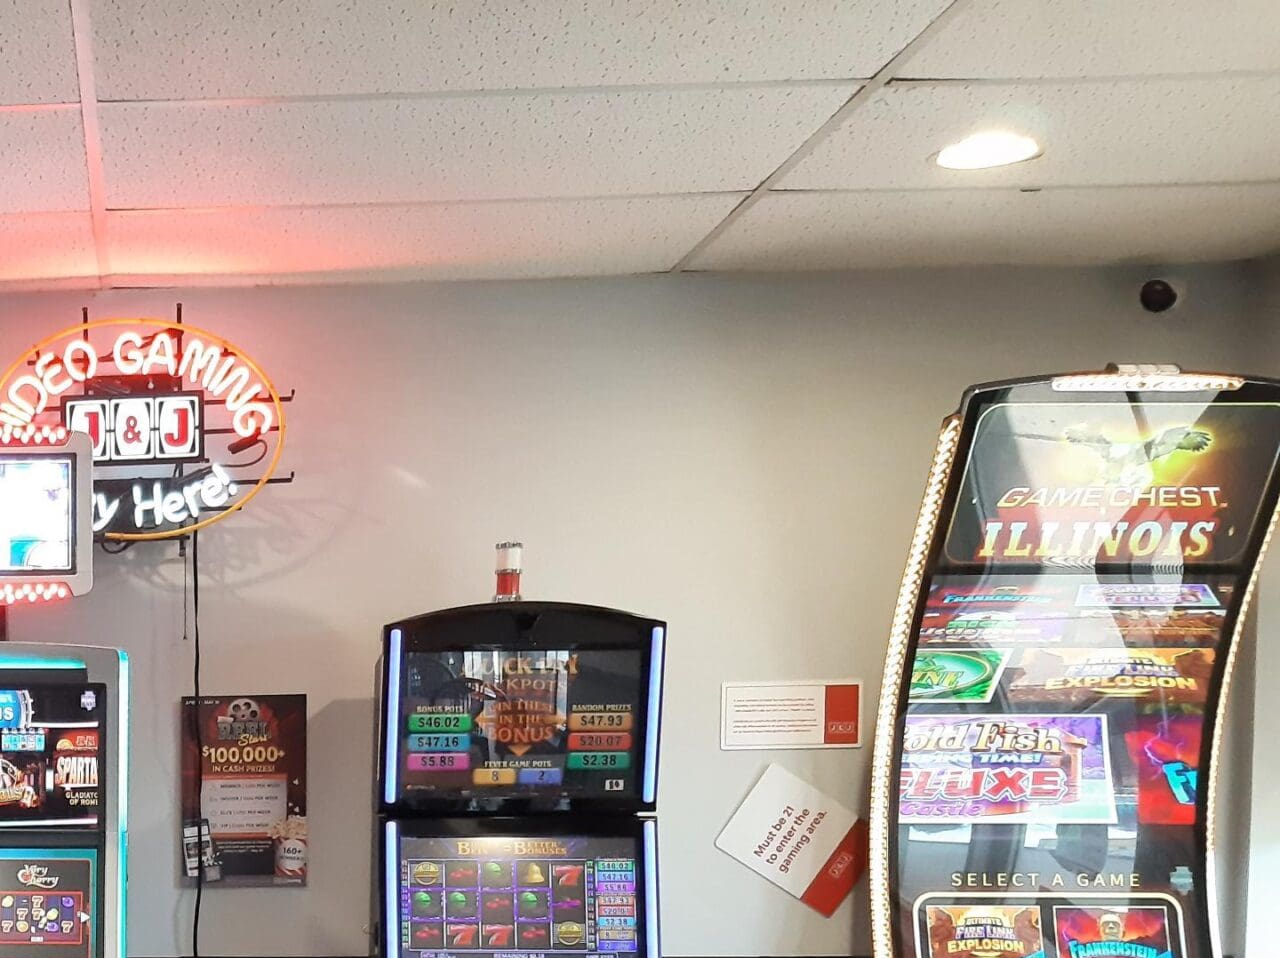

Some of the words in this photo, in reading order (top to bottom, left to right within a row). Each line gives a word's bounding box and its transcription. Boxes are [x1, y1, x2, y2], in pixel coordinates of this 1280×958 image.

[113, 332, 272, 438] GAMING
[132, 462, 238, 528] Here!
[996, 486, 1102, 508] GAME
[977, 521, 1216, 558] ILLINOIS
[1044, 675, 1198, 690] EXPLOSION
[418, 716, 460, 728] $46.02
[580, 714, 624, 727] $47.93
[417, 736, 459, 748] $47.16
[903, 723, 969, 751] old
[971, 721, 1063, 752] Fish
[202, 745, 285, 764] $100,000+
[582, 754, 617, 766] $2.38
[212, 765, 221, 773] IN
[223, 765, 245, 773] CASH
[537, 770, 545, 780] 2
[753, 832, 775, 858] Must
[772, 816, 787, 833] be
[783, 805, 796, 819] 21
[766, 852, 779, 865] to
[775, 826, 797, 854] enter
[793, 807, 811, 827] the
[778, 834, 811, 874] gaming
[806, 809, 828, 836] area.
[950, 872, 1039, 887] SELECT
[1051, 873, 1065, 887] A
[1076, 873, 1141, 887] GAME
[948, 939, 1024, 953] EXPLOSION
